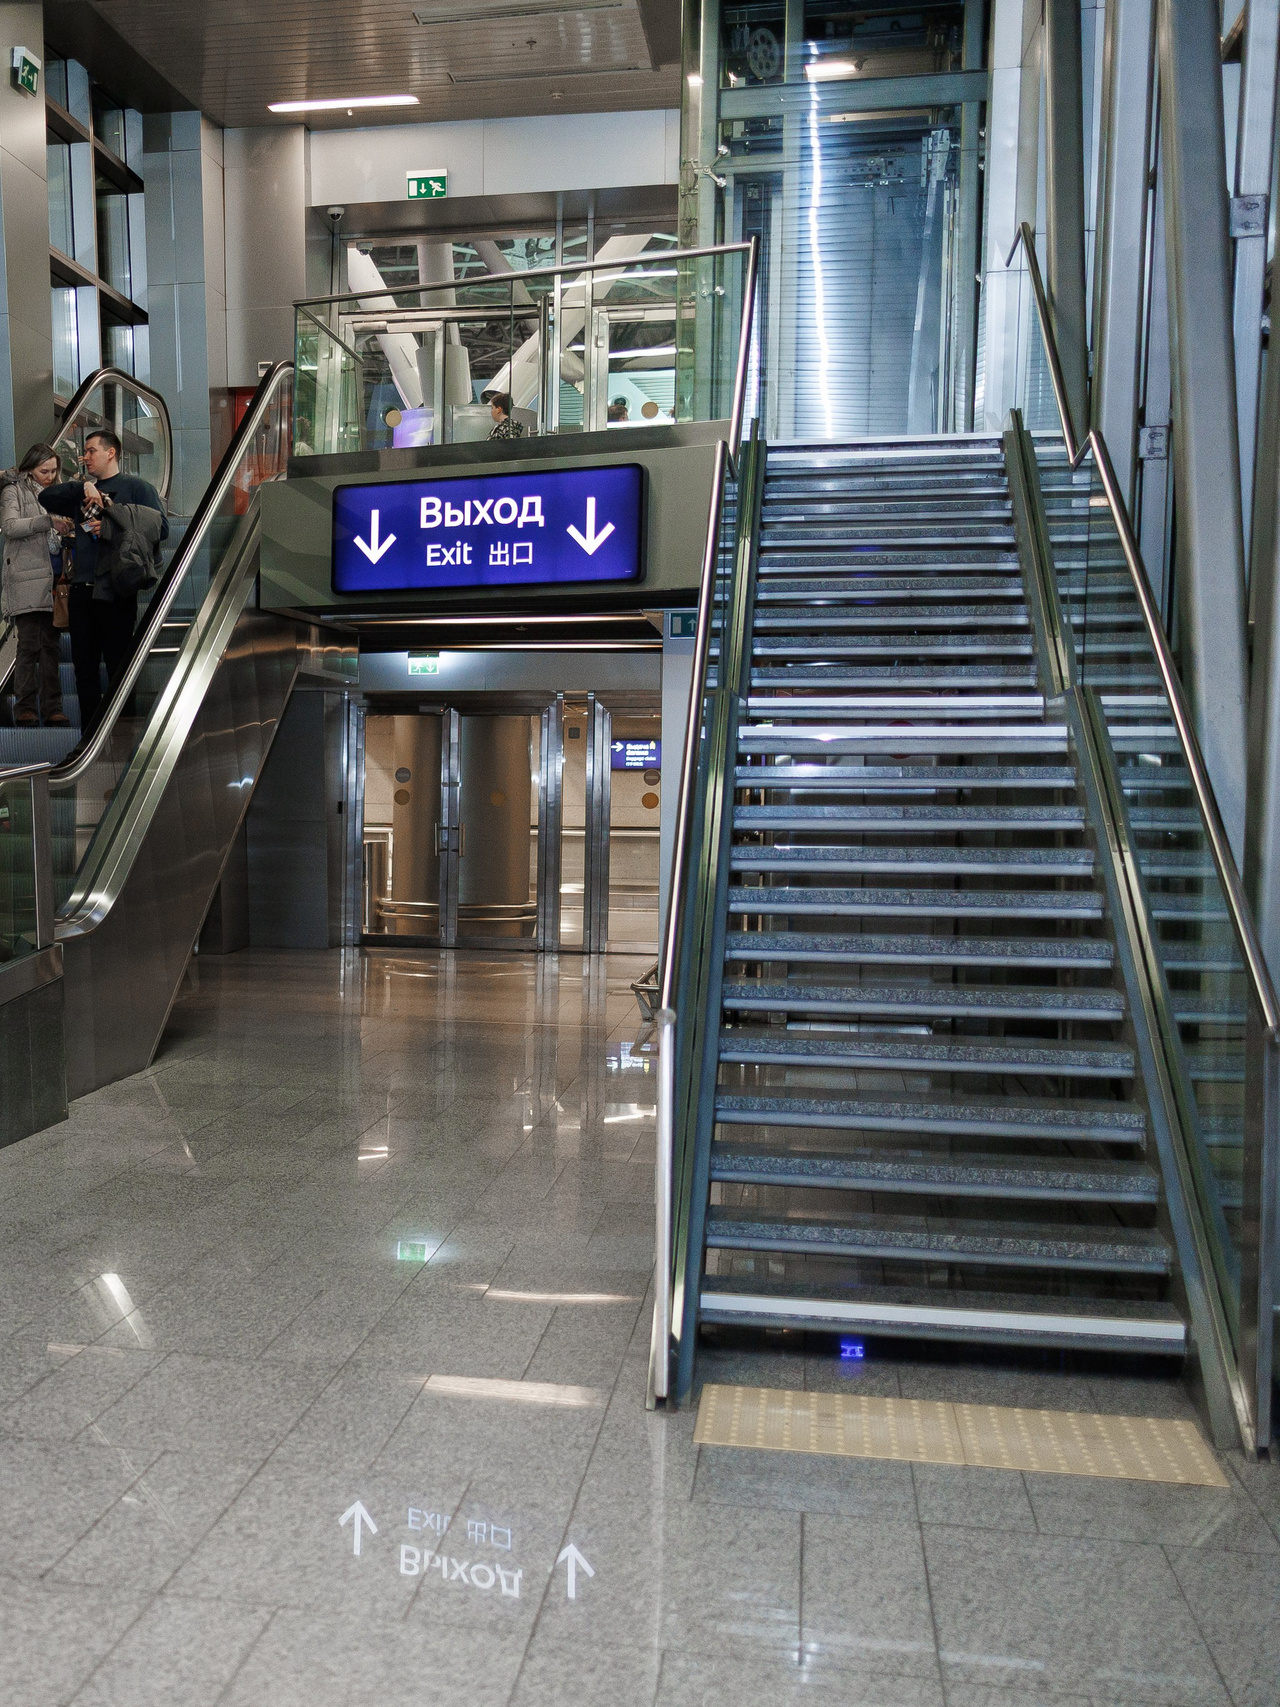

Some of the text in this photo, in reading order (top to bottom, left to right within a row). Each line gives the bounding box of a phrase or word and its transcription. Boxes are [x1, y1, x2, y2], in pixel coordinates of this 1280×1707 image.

[419, 495, 545, 529] Выход
[426, 540, 534, 567] Exit 出口
